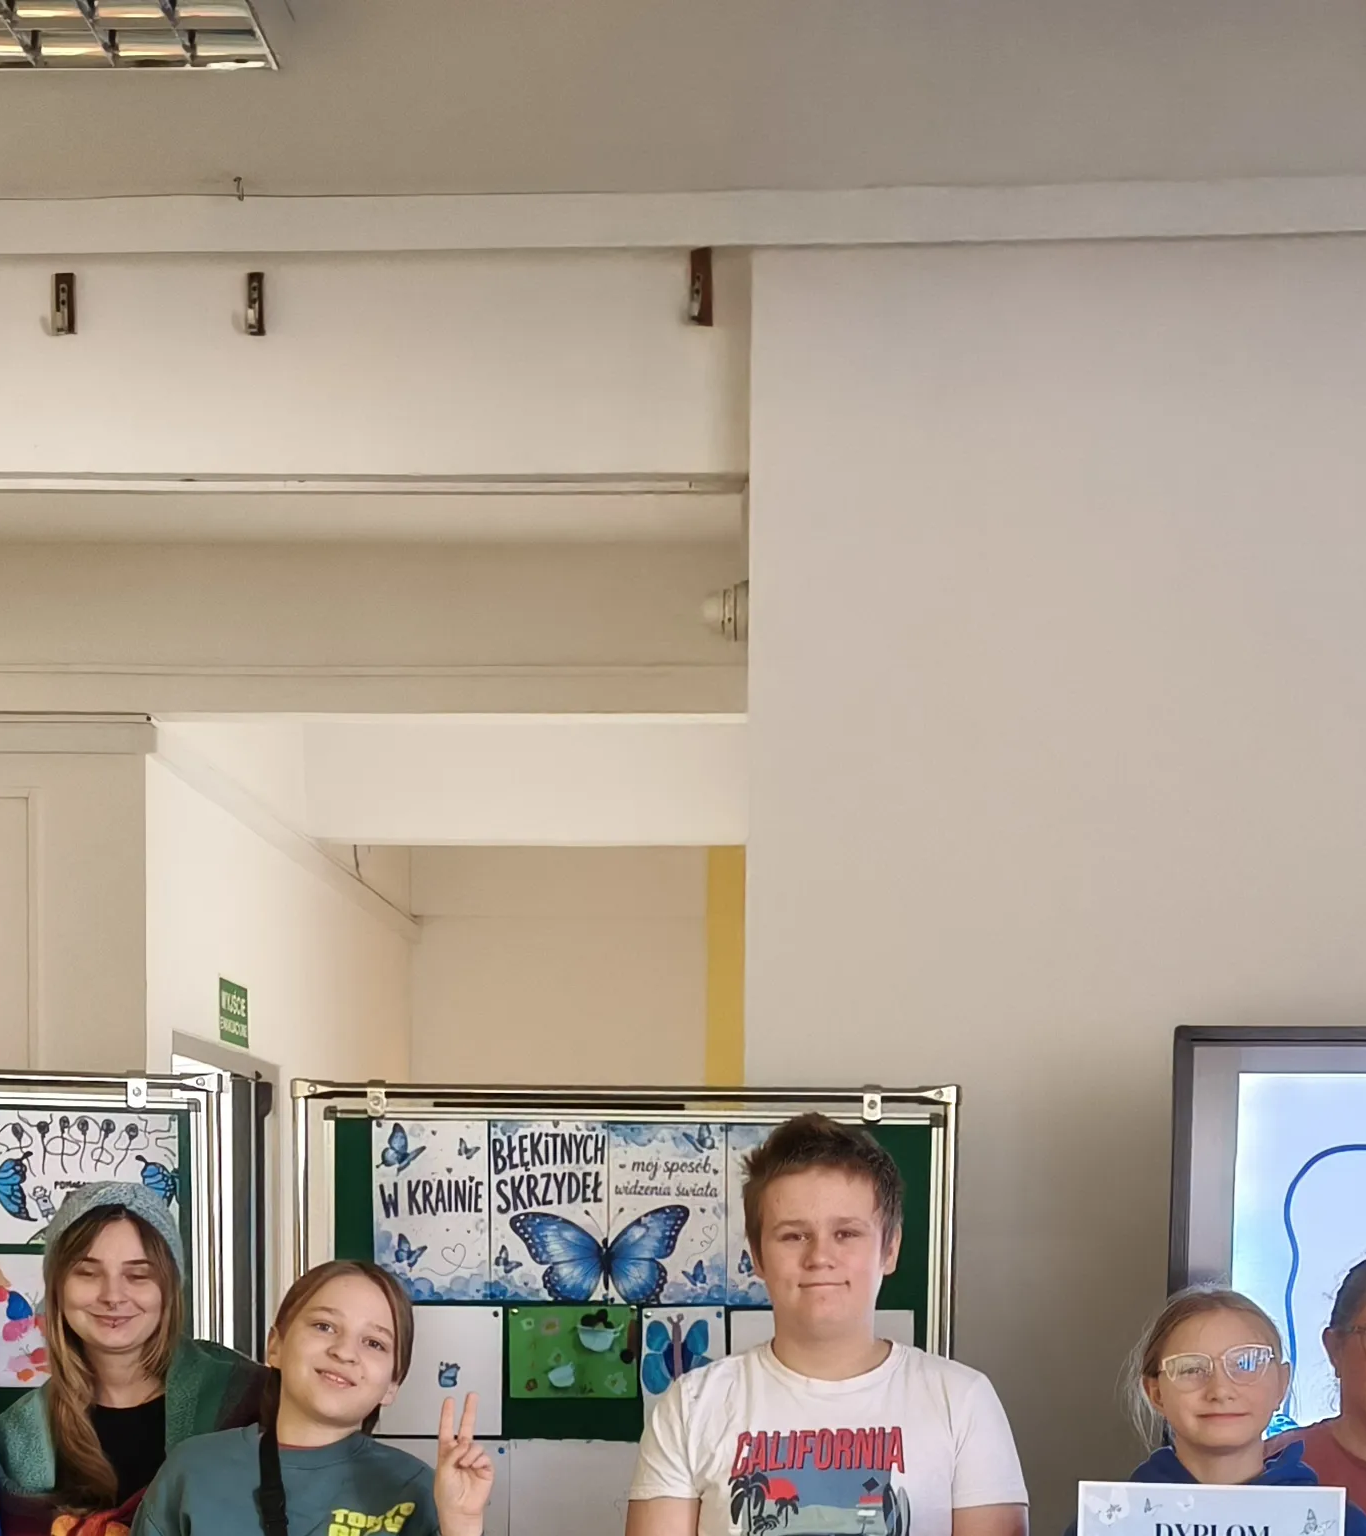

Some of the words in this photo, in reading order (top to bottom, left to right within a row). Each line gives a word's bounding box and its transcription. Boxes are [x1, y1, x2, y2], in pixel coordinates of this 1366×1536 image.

[379, 1182, 399, 1219] W
[496, 1171, 603, 1214] SKRZYDEŁ
[614, 1179, 671, 1196] widzenia
[675, 1181, 718, 1197] świata
[732, 1426, 906, 1476] CALIFORNIA
